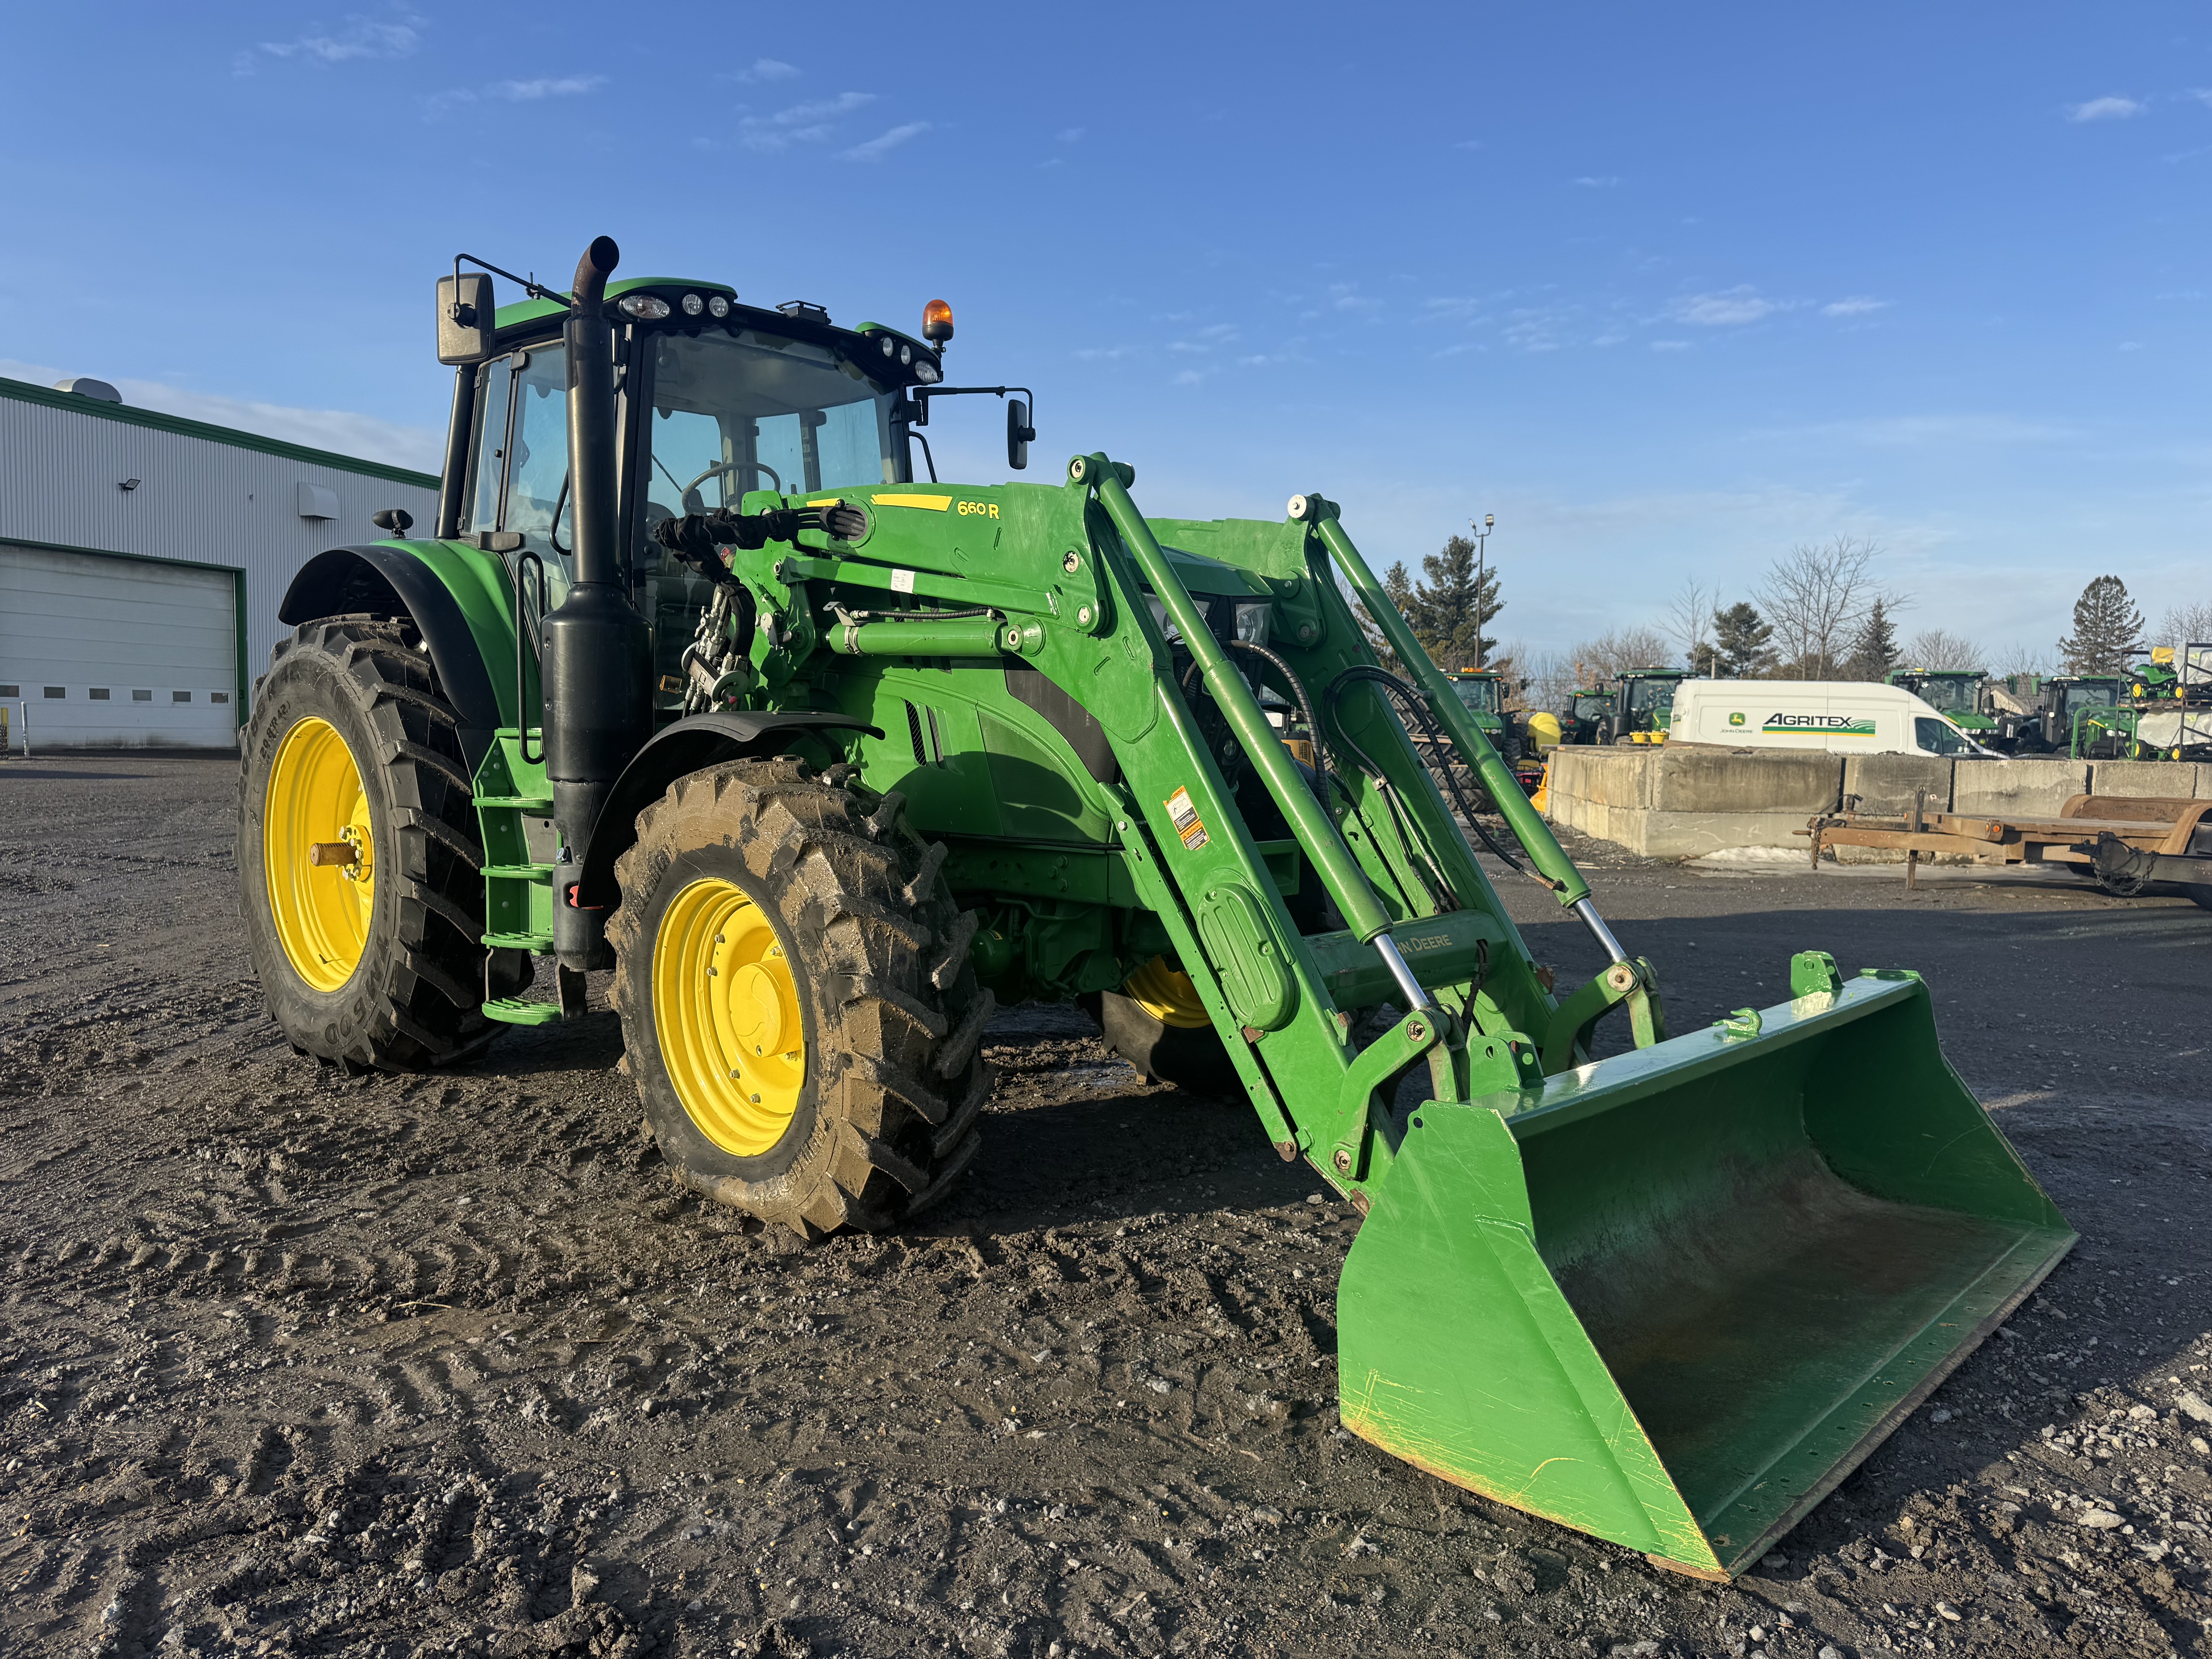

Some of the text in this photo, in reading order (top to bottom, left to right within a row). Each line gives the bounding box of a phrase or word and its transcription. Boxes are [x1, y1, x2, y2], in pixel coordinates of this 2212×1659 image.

[239, 689, 245, 699] 3
[1763, 713, 1852, 728] AGRITEX
[330, 674, 385, 809] TRELLEBORG
[1396, 934, 1453, 954] HN DEERE
